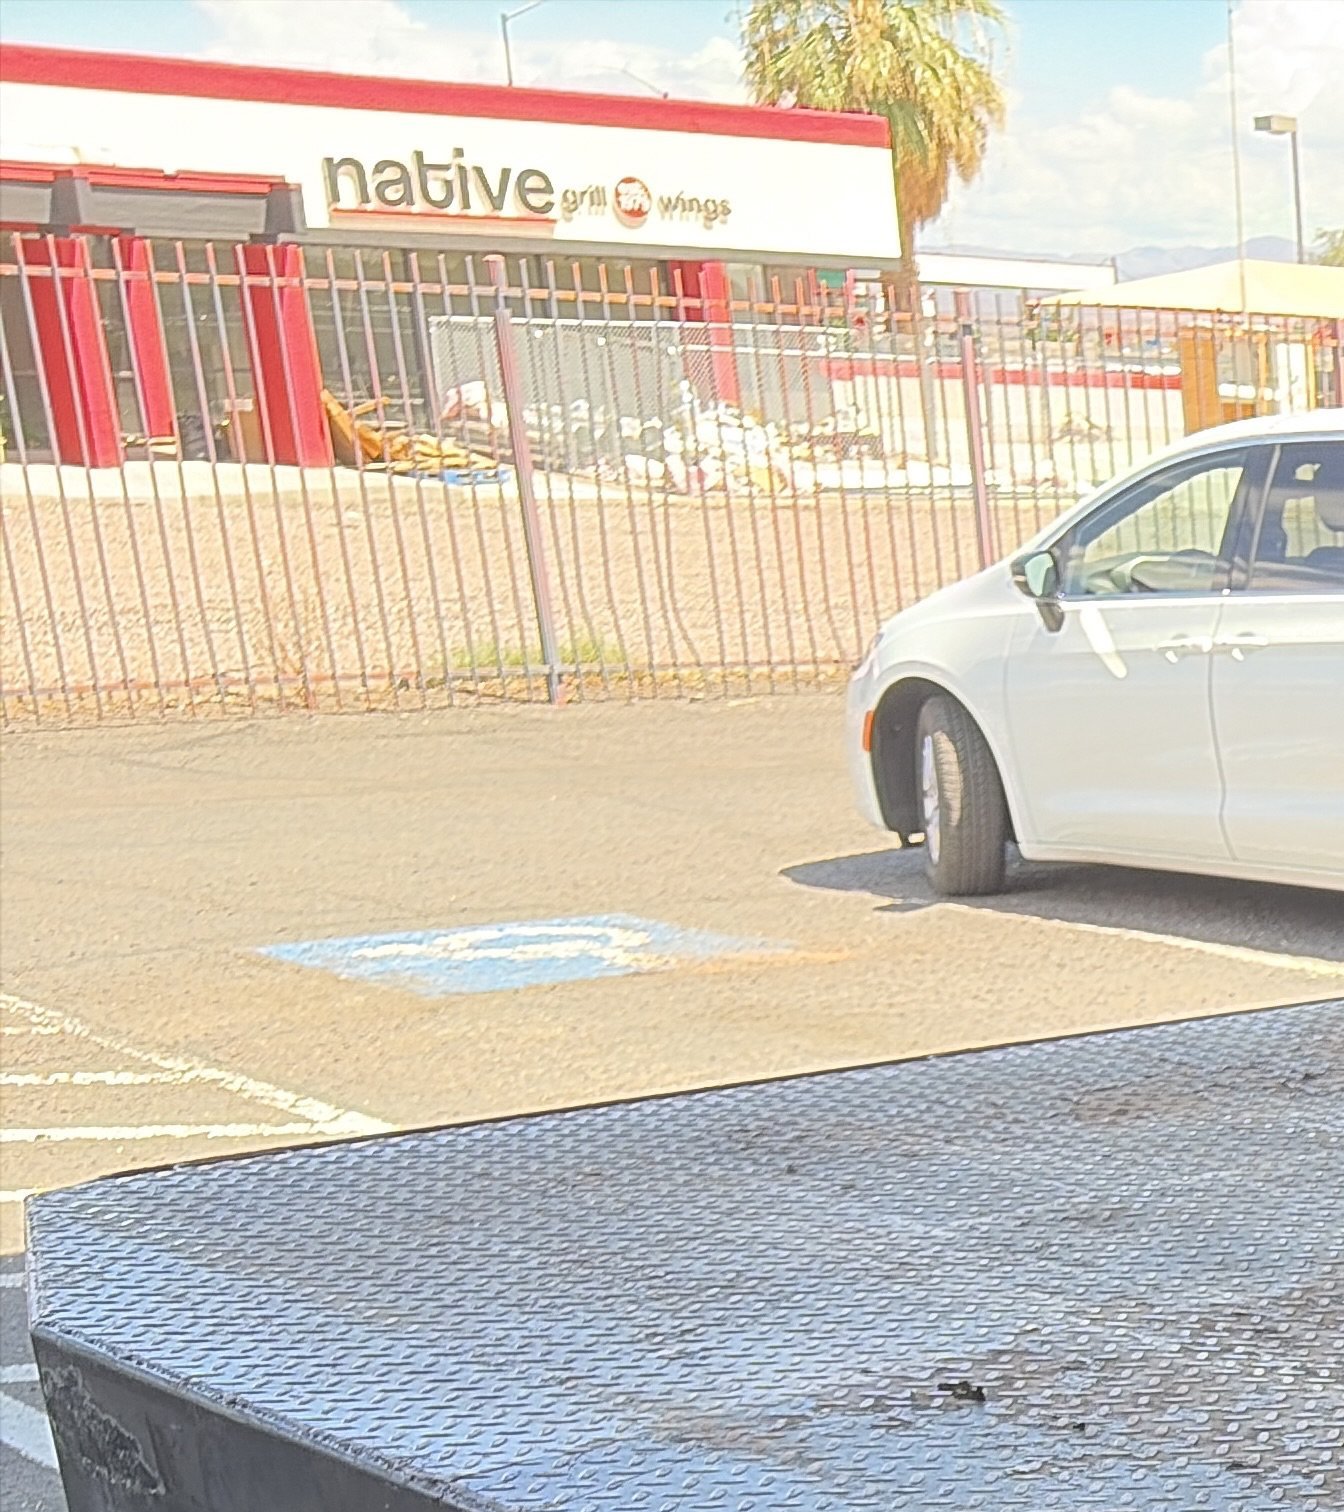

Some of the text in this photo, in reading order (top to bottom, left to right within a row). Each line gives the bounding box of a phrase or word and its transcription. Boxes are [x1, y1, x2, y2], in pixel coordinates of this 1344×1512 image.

[323, 147, 556, 215] native
[562, 184, 607, 213] grill
[658, 190, 732, 222] wings
